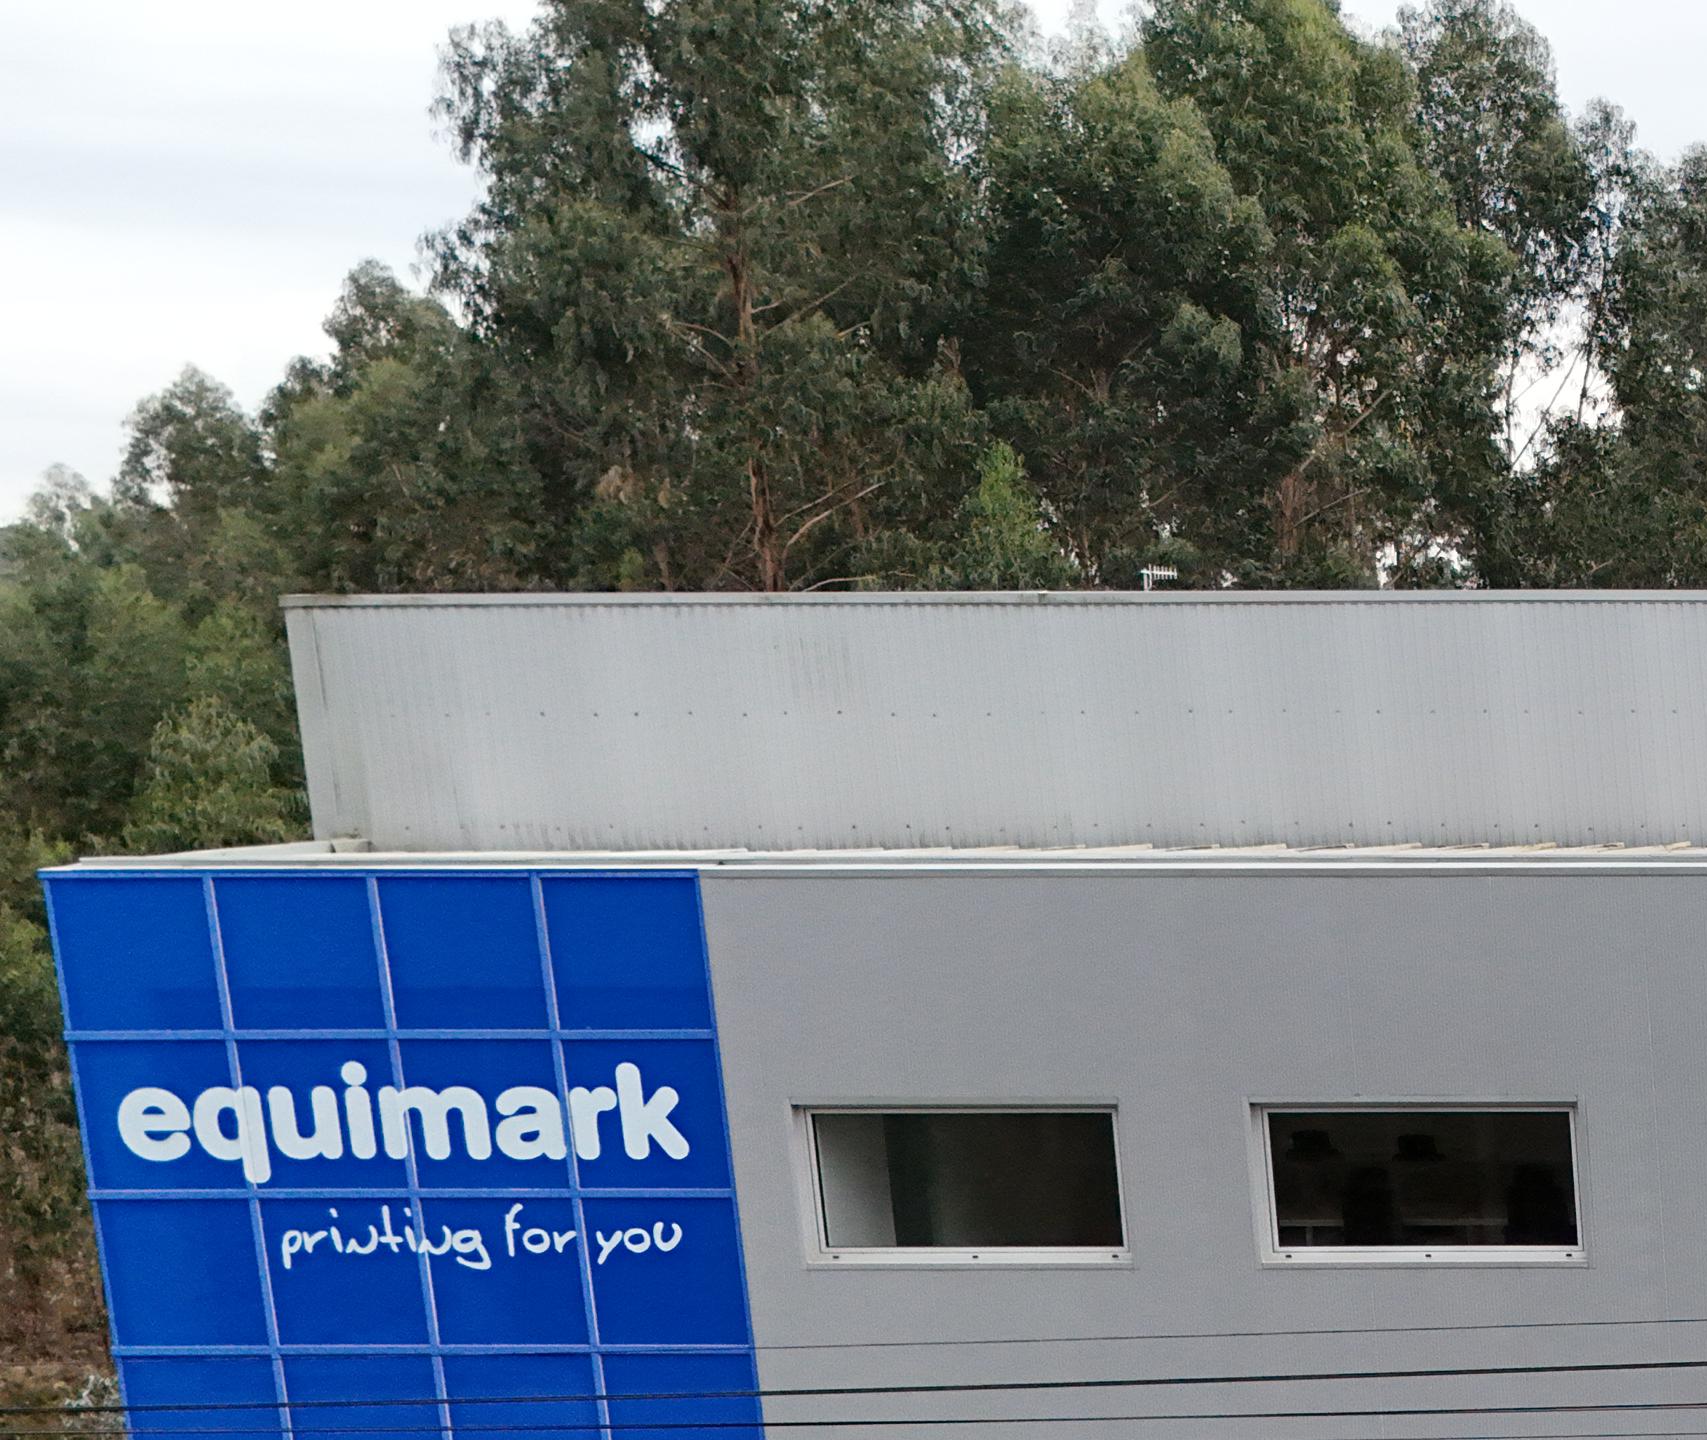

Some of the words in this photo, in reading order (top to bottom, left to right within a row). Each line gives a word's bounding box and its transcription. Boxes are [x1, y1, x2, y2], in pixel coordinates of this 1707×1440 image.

[117, 1060, 691, 1185] equimark
[281, 1204, 491, 1271] printing
[505, 1202, 578, 1258] for
[596, 1221, 683, 1265] you
